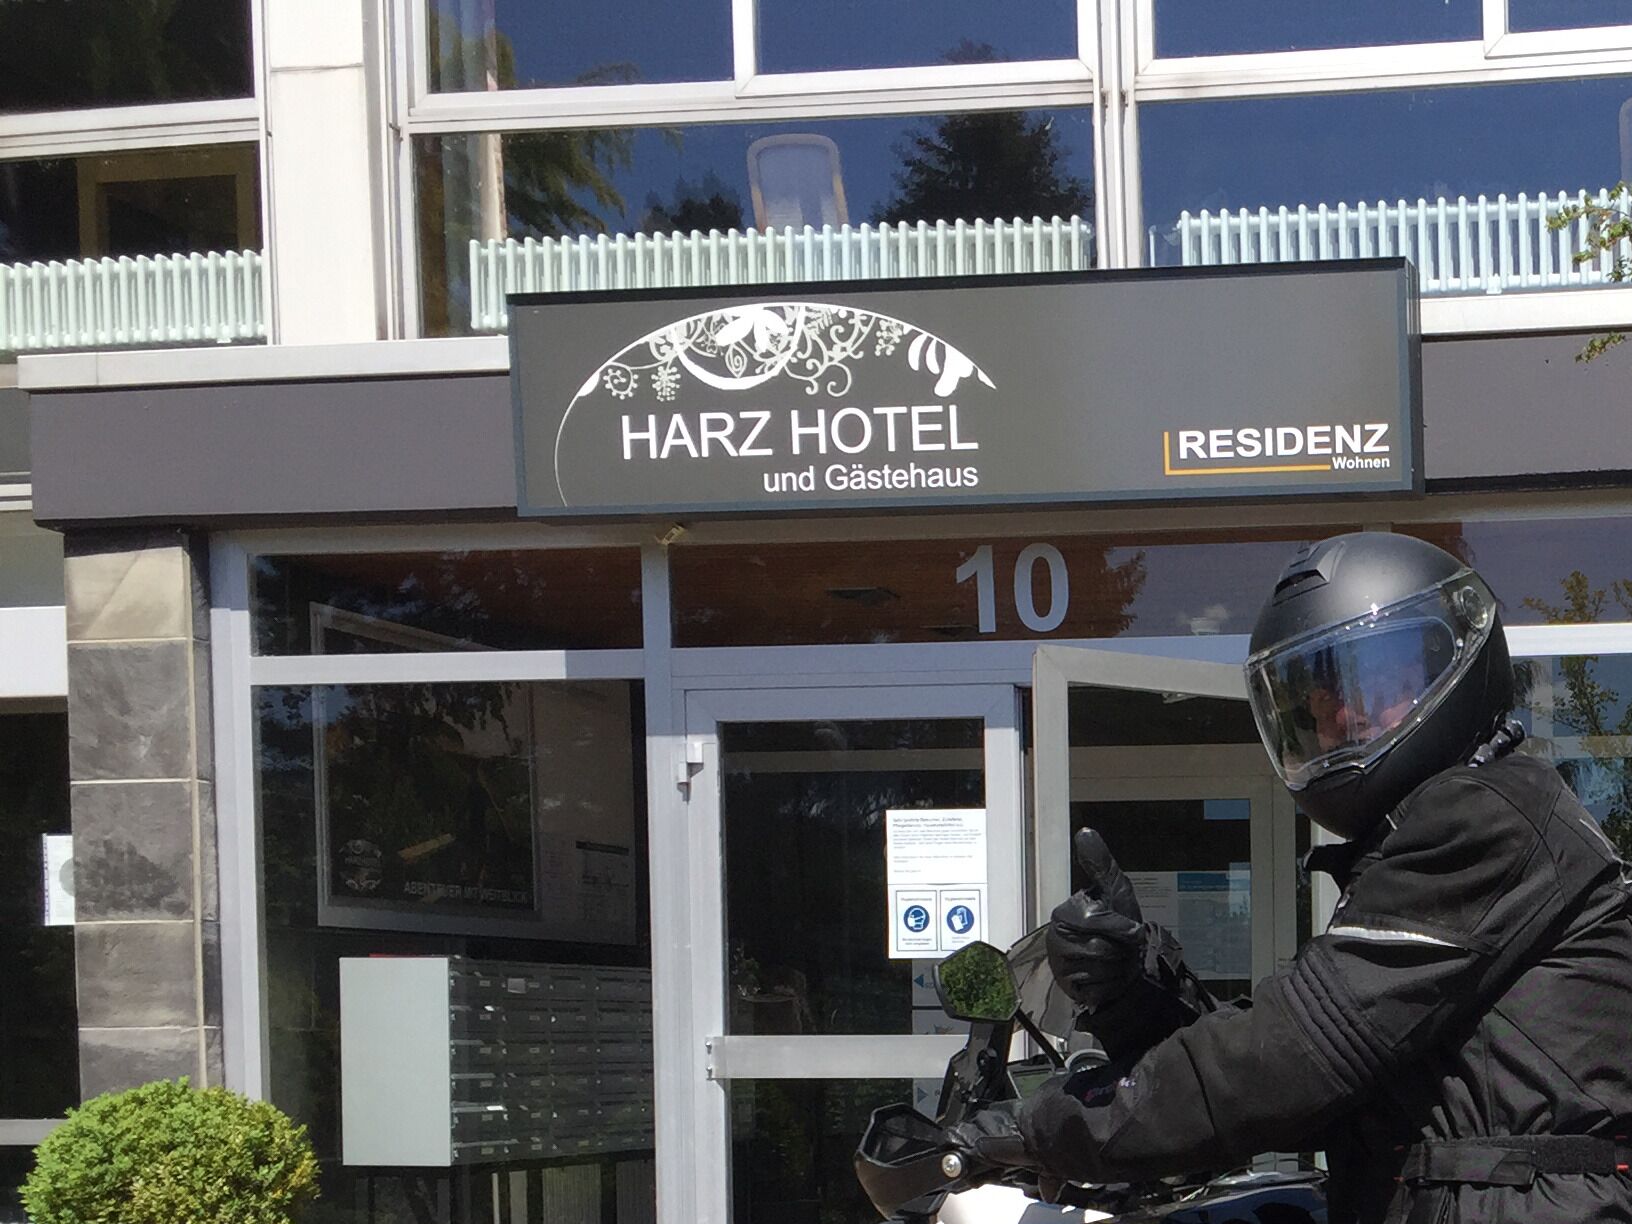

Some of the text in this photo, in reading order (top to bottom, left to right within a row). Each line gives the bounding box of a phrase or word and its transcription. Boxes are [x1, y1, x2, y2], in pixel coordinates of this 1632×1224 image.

[621, 405, 979, 460] HARZ HOTEL
[1178, 423, 1391, 459] RESIDENZ
[763, 462, 979, 492] und Gästehaus
[1332, 456, 1391, 470] Wohnen
[956, 542, 1070, 633] 10
